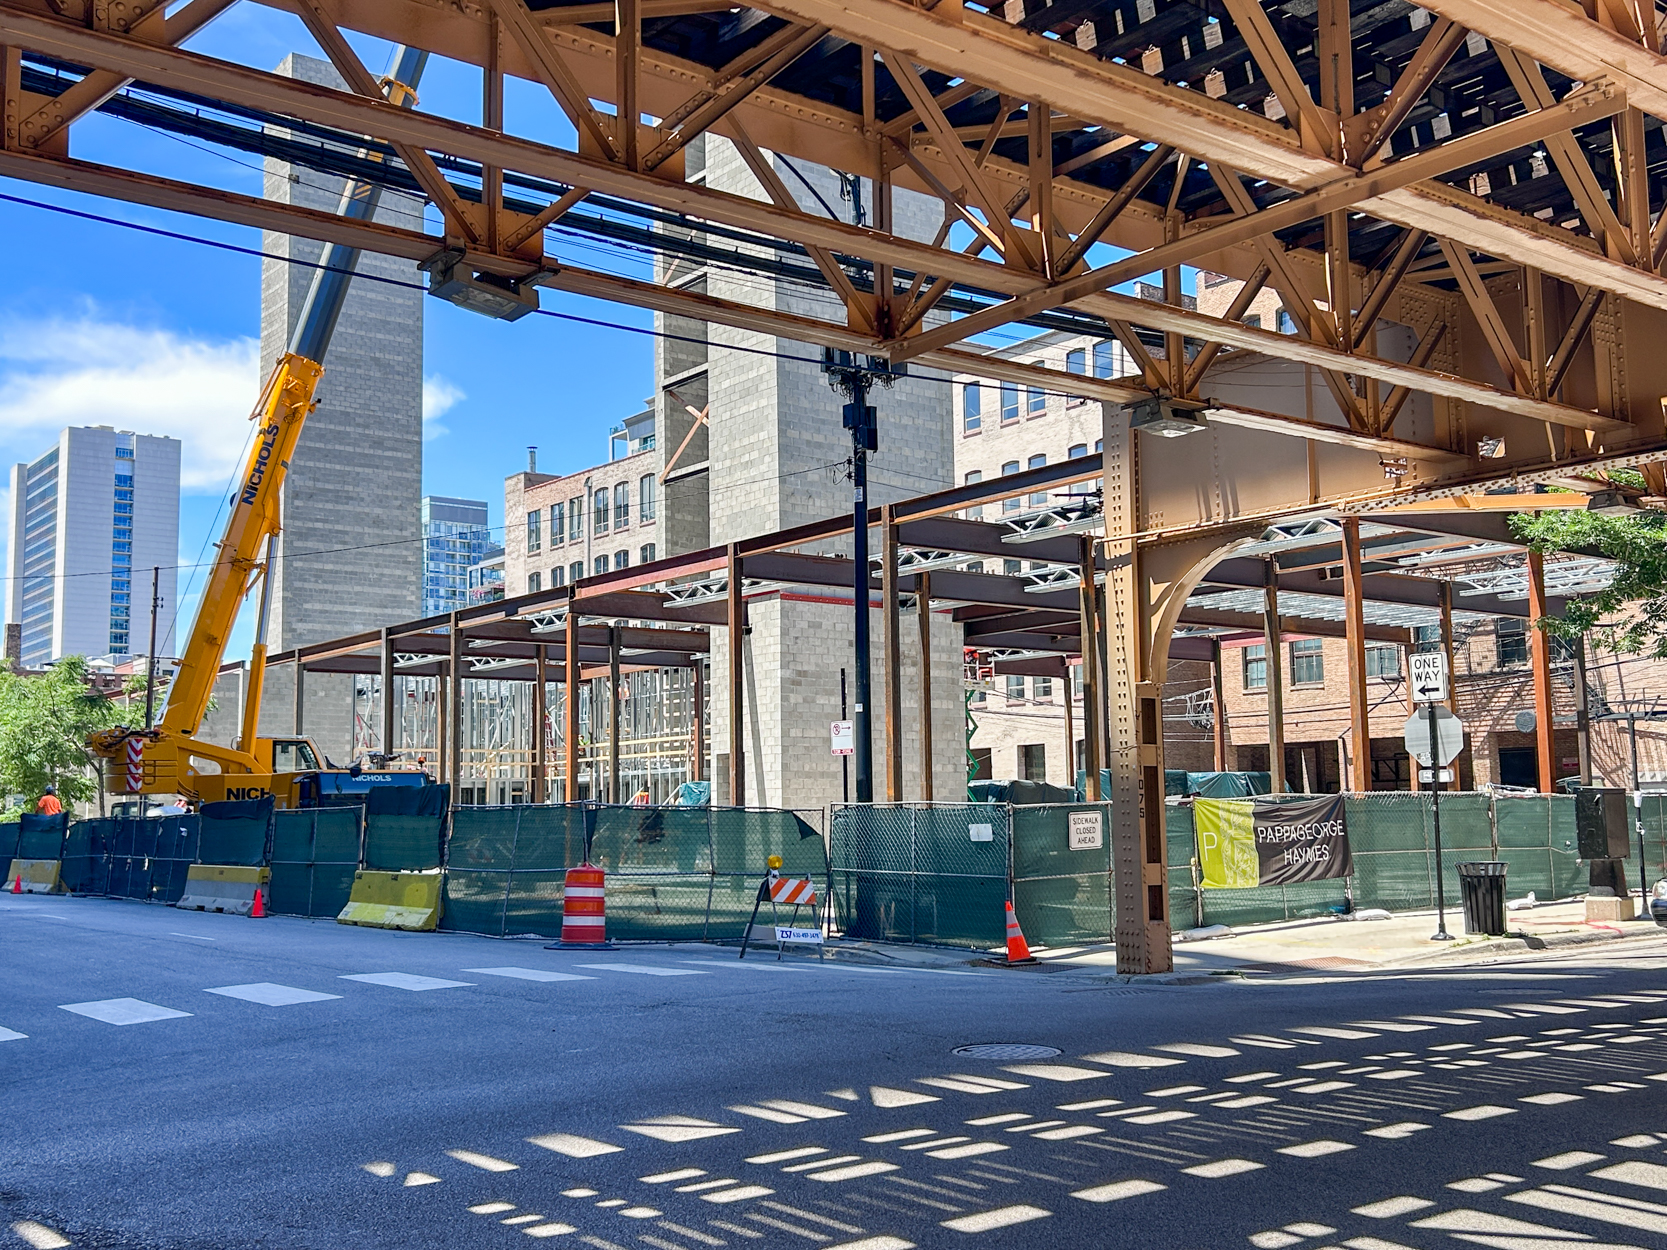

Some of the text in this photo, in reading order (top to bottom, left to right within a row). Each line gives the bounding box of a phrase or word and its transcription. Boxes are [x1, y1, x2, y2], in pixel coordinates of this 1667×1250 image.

[241, 424, 280, 506] NICHOLS
[1414, 657, 1440, 670] ONE
[1414, 669, 1440, 682] WAY
[1072, 816, 1099, 825] SIDEWALK
[1075, 826, 1097, 835] CLOSED
[1257, 819, 1345, 844] PAPPAGEORGE
[1077, 836, 1096, 845] AHEAD
[1202, 832, 1218, 862] P
[1283, 844, 1331, 866] HAYMES
